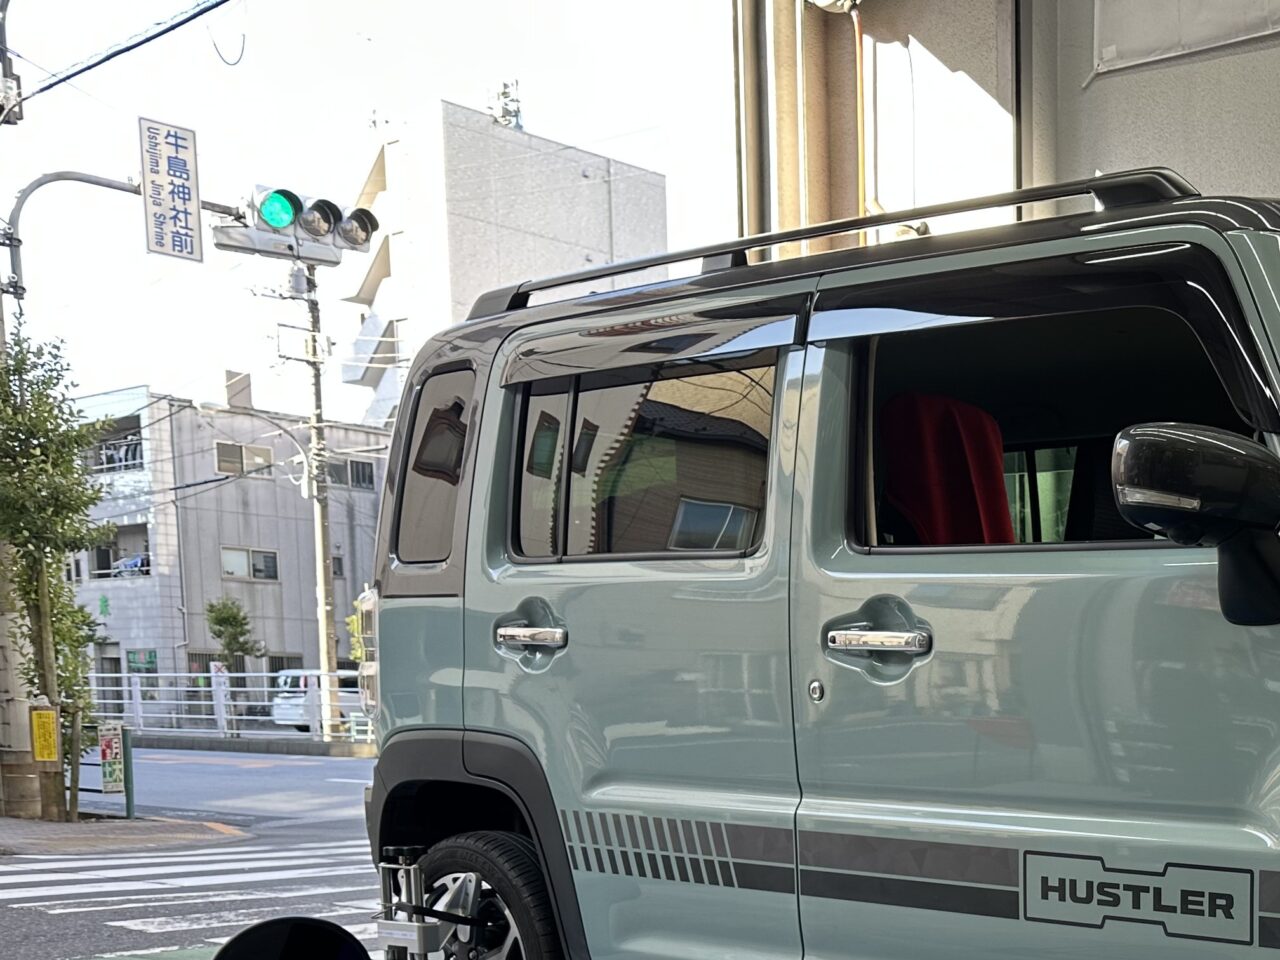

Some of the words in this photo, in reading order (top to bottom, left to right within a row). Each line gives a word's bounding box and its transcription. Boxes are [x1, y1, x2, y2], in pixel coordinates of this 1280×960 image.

[146, 126, 161, 175] Ushijima
[149, 180, 164, 207] Jinja
[164, 129, 194, 256] 牛島神社前
[153, 212, 168, 248] Shrine
[1040, 875, 1235, 920] HUSTLER
